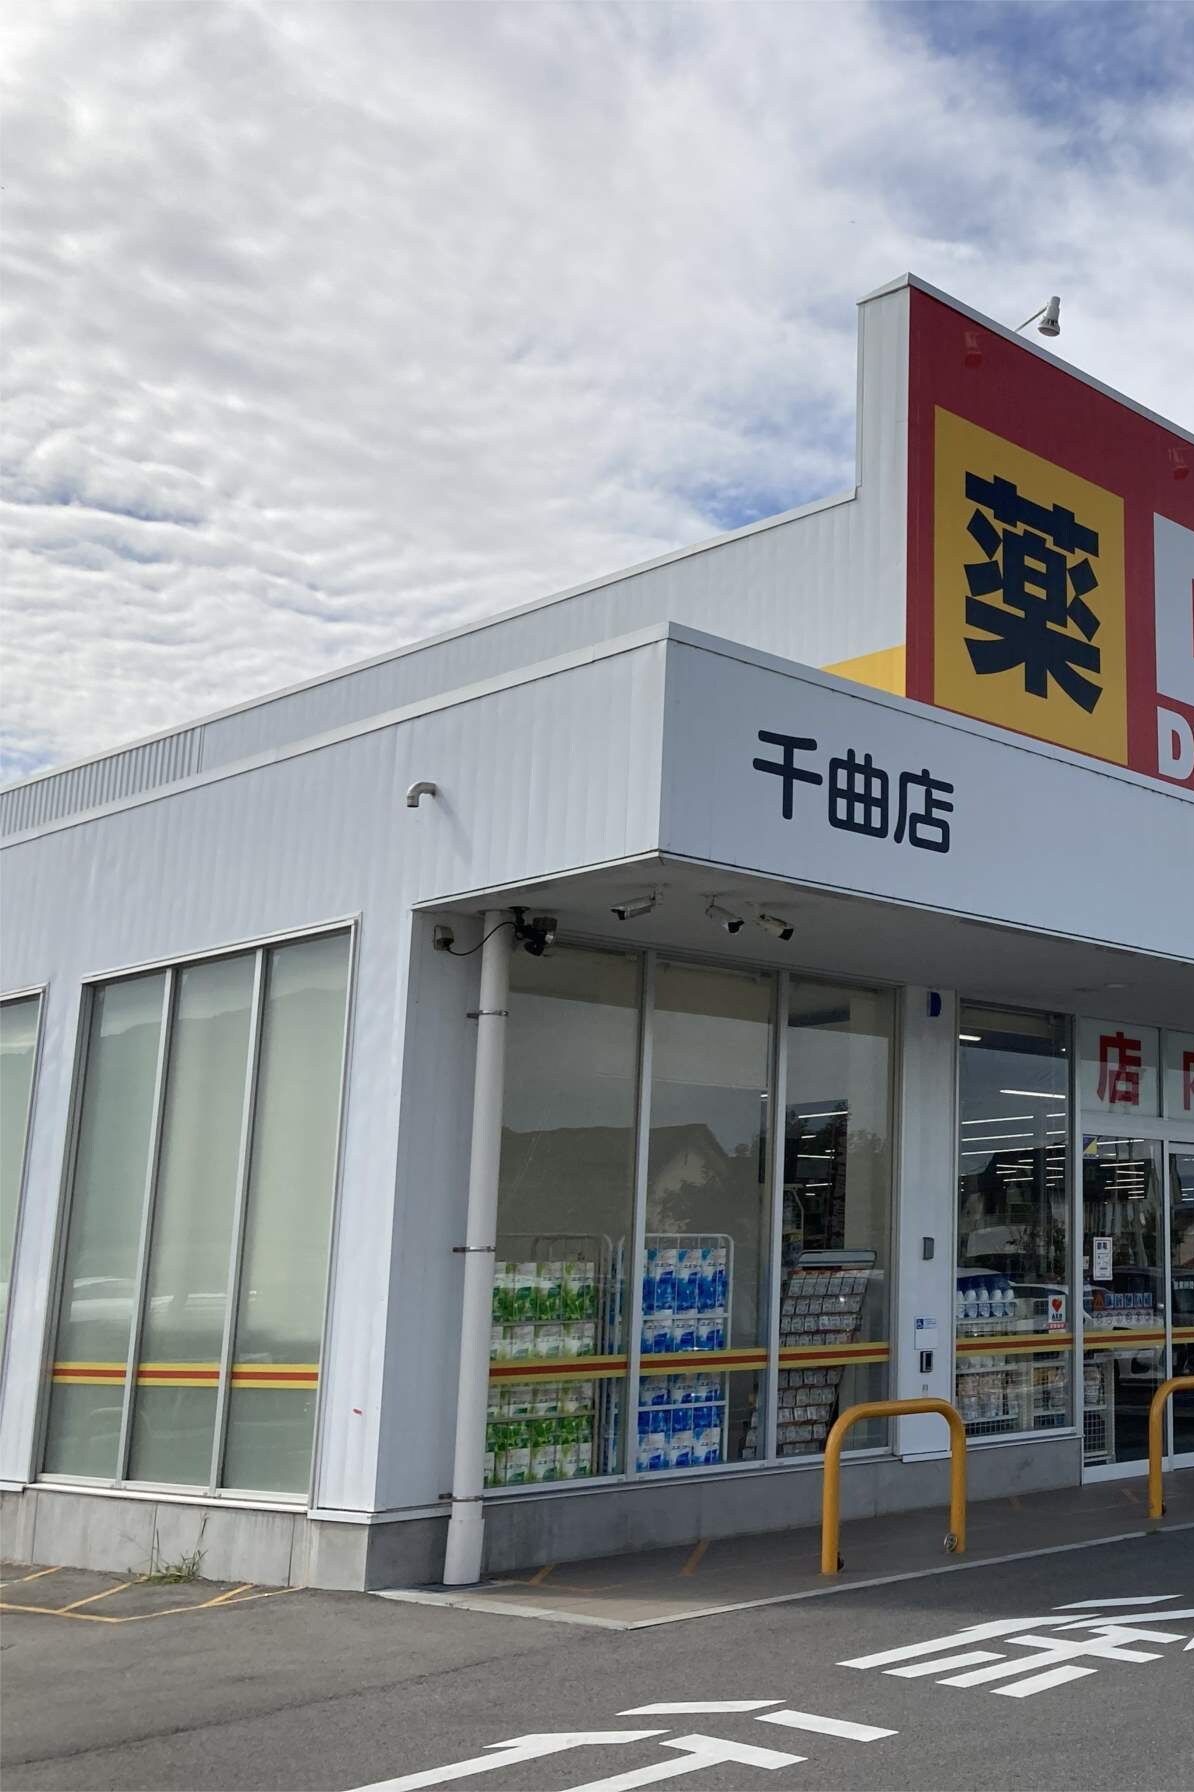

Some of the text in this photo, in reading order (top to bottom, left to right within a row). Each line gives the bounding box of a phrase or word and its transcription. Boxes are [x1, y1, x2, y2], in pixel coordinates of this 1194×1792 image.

[963, 471, 1103, 714] 薬
[753, 729, 954, 854] 千曲店
